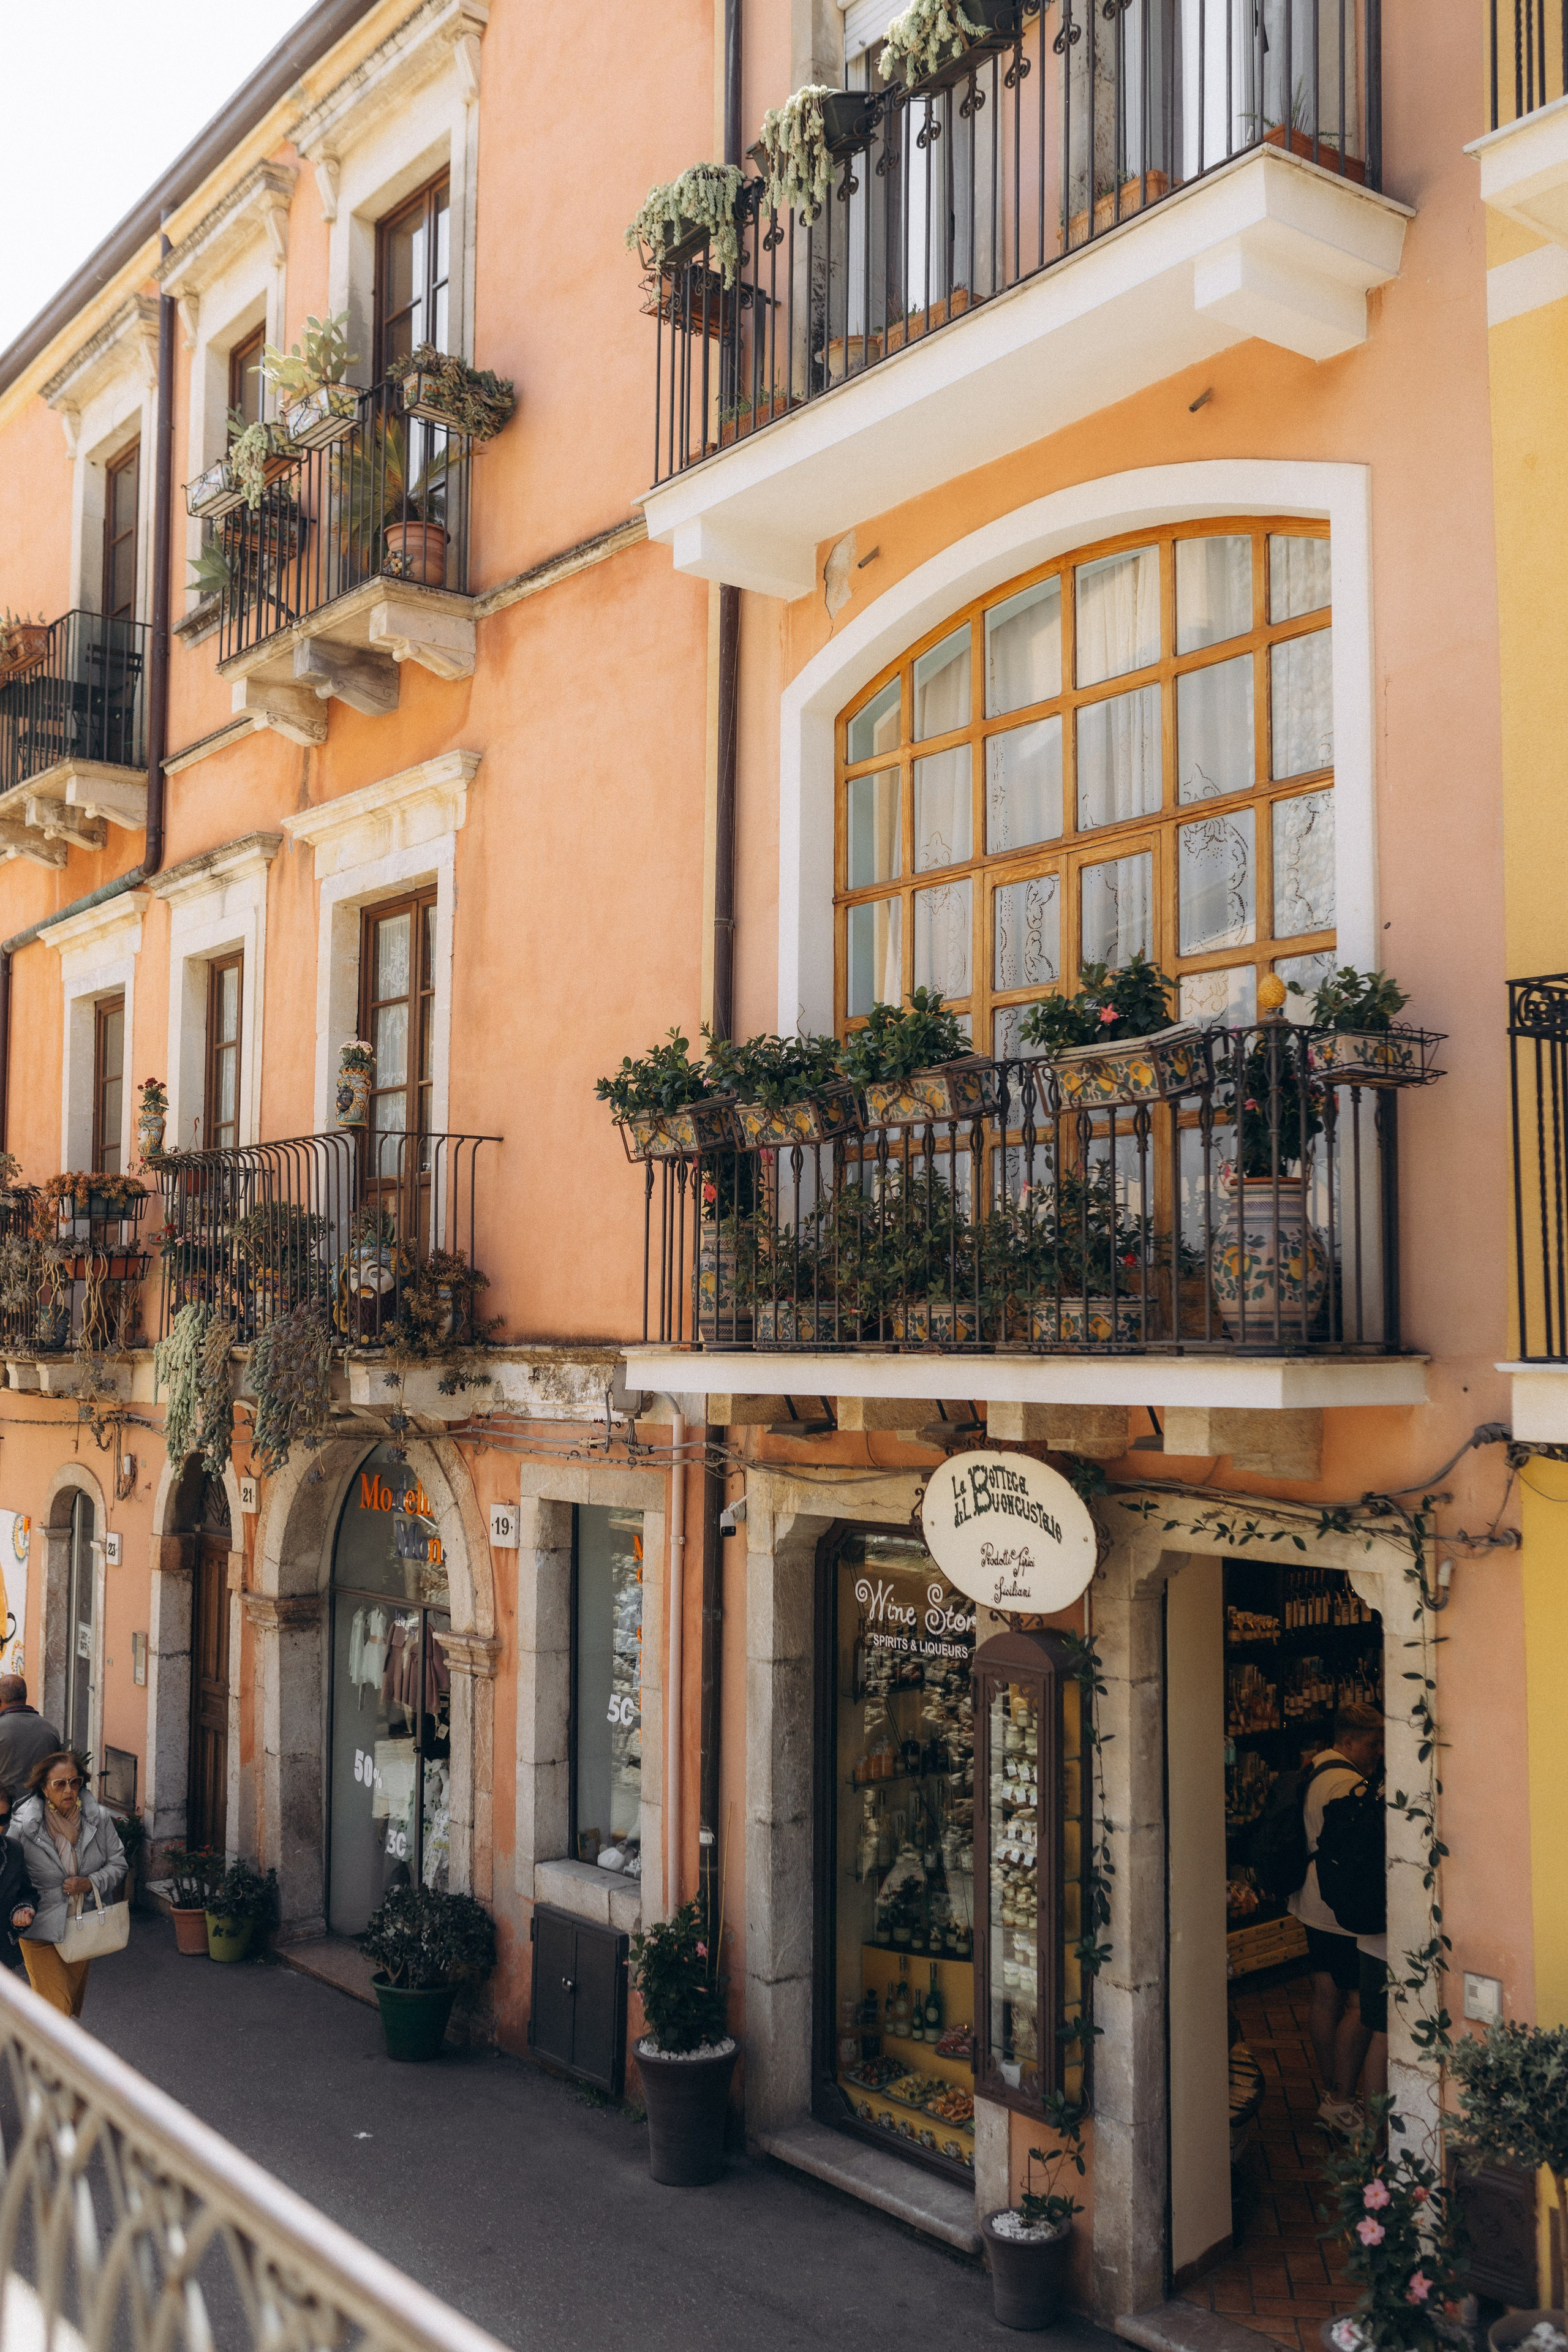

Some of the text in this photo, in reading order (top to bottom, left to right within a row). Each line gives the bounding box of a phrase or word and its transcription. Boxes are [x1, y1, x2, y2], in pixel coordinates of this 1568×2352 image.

[243, 1487, 252, 1504] 21
[495, 1517, 510, 1536] 19
[108, 1542, 116, 1557] 23
[394, 1520, 447, 1564] Mon
[981, 1542, 1035, 1577] Prodotti Tipici
[993, 1576, 1031, 1604] Siciliani
[855, 1578, 976, 1635] Wine Stor
[873, 1634, 968, 1659] SPIRITS & LIQUEURS
[354, 1749, 383, 1789] 50%
